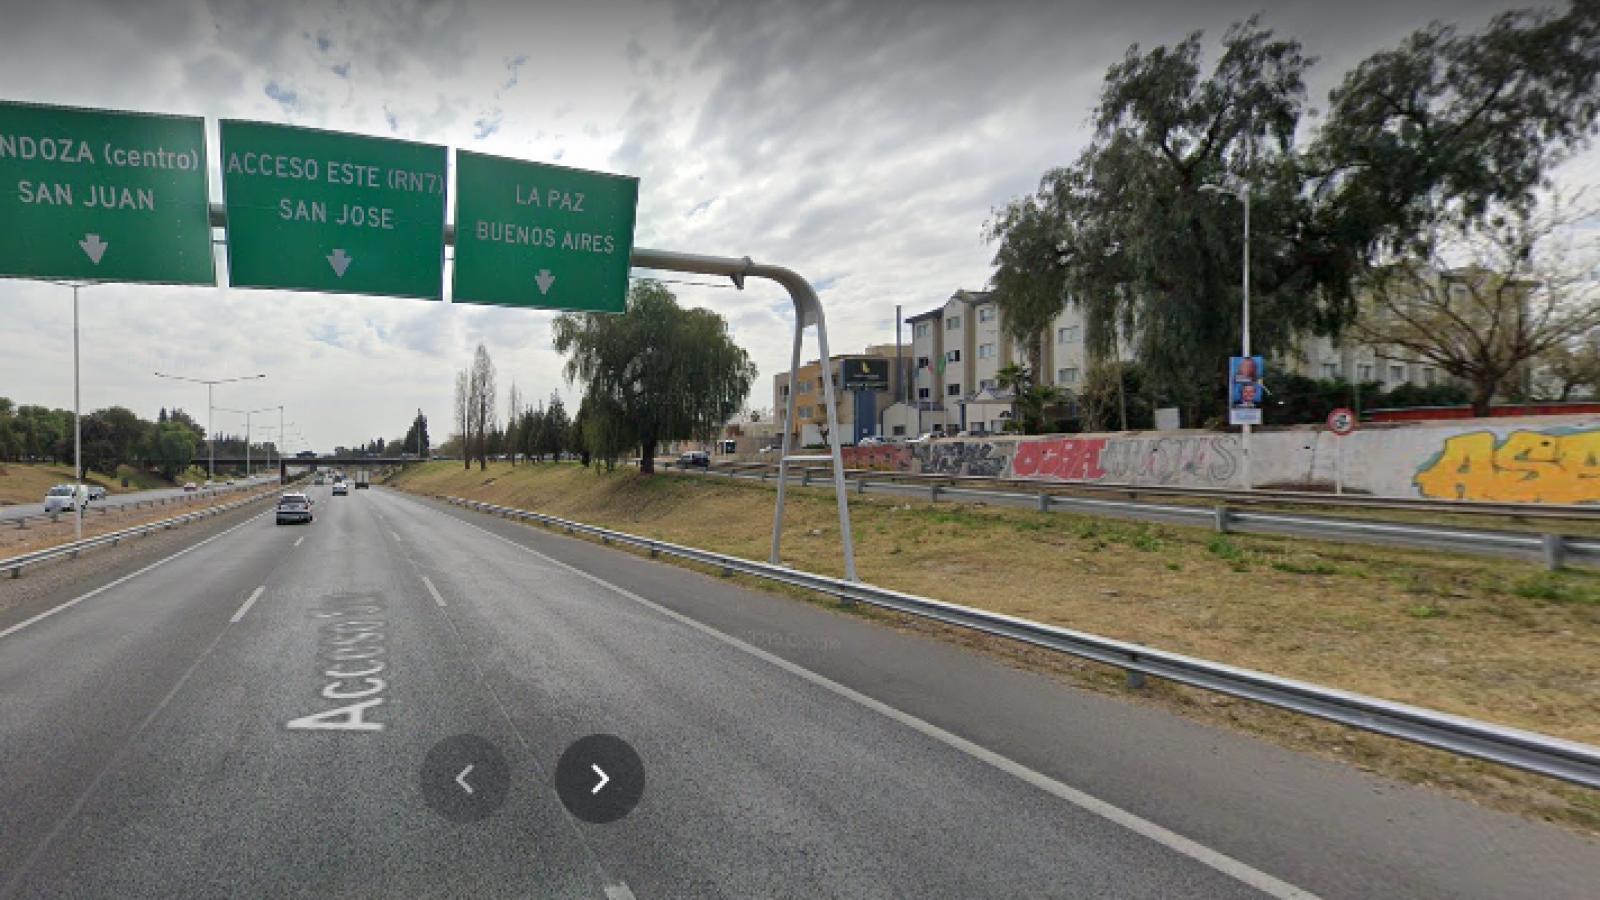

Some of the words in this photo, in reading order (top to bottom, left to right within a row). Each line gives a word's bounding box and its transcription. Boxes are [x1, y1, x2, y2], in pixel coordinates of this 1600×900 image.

[0, 134, 95, 165] NDOZA
[104, 143, 199, 171] (centro)
[226, 151, 319, 181] ACCESO
[327, 161, 380, 187] ESTE
[387, 167, 444, 194] (RN7)
[18, 181, 73, 205] SAN
[83, 185, 155, 211] JUAN
[516, 183, 541, 207] LA
[547, 190, 585, 212] PAZ
[279, 198, 327, 223] SAN
[336, 203, 394, 230] JOSE
[476, 220, 556, 248] BUENOS
[561, 231, 616, 254] AIRES
